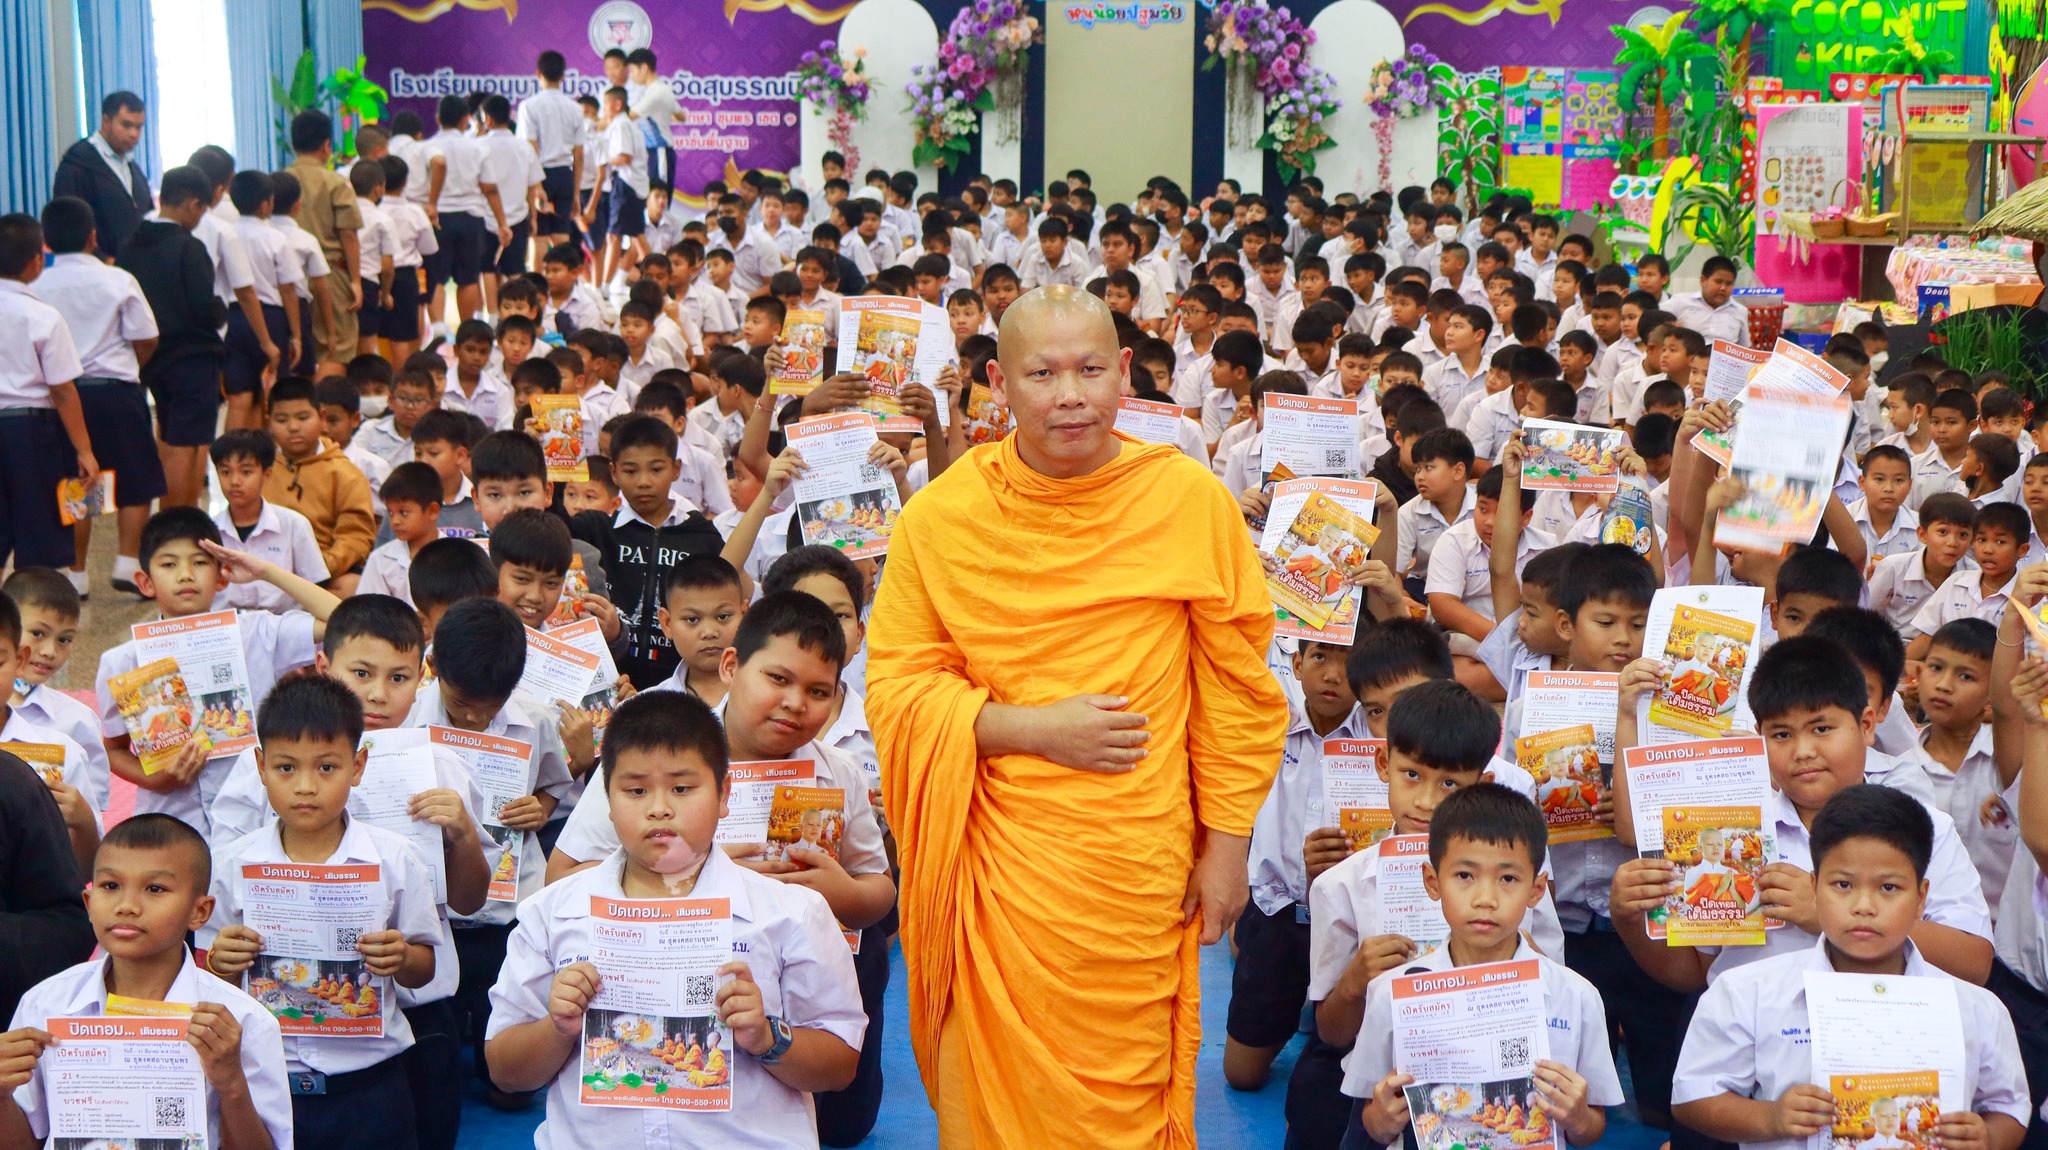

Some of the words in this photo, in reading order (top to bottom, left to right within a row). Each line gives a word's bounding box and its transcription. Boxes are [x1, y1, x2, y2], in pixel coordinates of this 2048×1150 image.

[1790, 0, 1967, 40] COCONUT
[1543, 676, 1589, 686] ปิดเทอม...
[1668, 695, 1716, 717] เติมธรรม
[1646, 747, 1704, 762] ปิดเทอม...
[262, 867, 320, 880] ปิดเทอม...
[1700, 897, 1737, 908] ปิดเทอม
[608, 903, 671, 918] ปิดเทอม...
[677, 908, 711, 917] เติมธรรม
[1687, 903, 1745, 920] เติมธรรม
[1413, 976, 1477, 993] ปิดเทอม...
[69, 1023, 135, 1036] ปิดเทอม...
[662, 1095, 674, 1104] โทร
